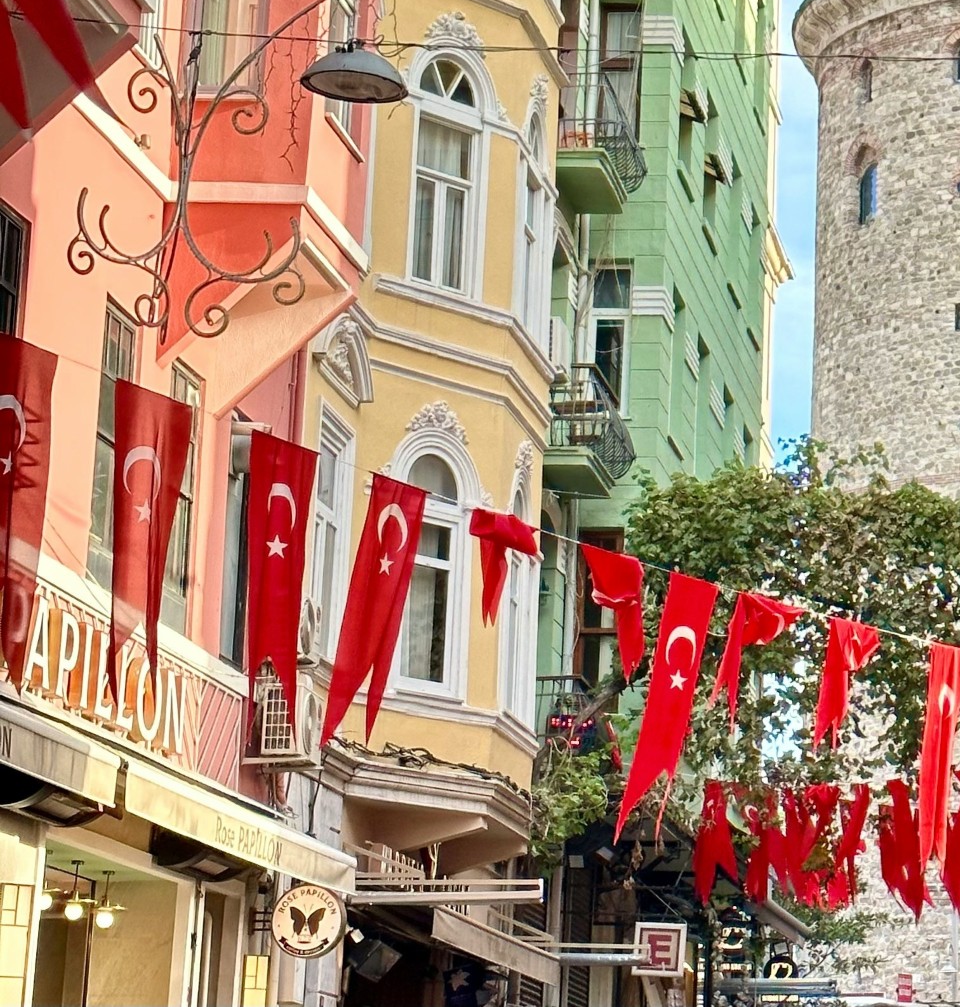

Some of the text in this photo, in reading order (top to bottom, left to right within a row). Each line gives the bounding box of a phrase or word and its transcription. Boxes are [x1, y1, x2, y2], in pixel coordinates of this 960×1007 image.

[24, 596, 189, 754] APILLON
[215, 815, 235, 848] Rose
[278, 892, 298, 914] ROSE
